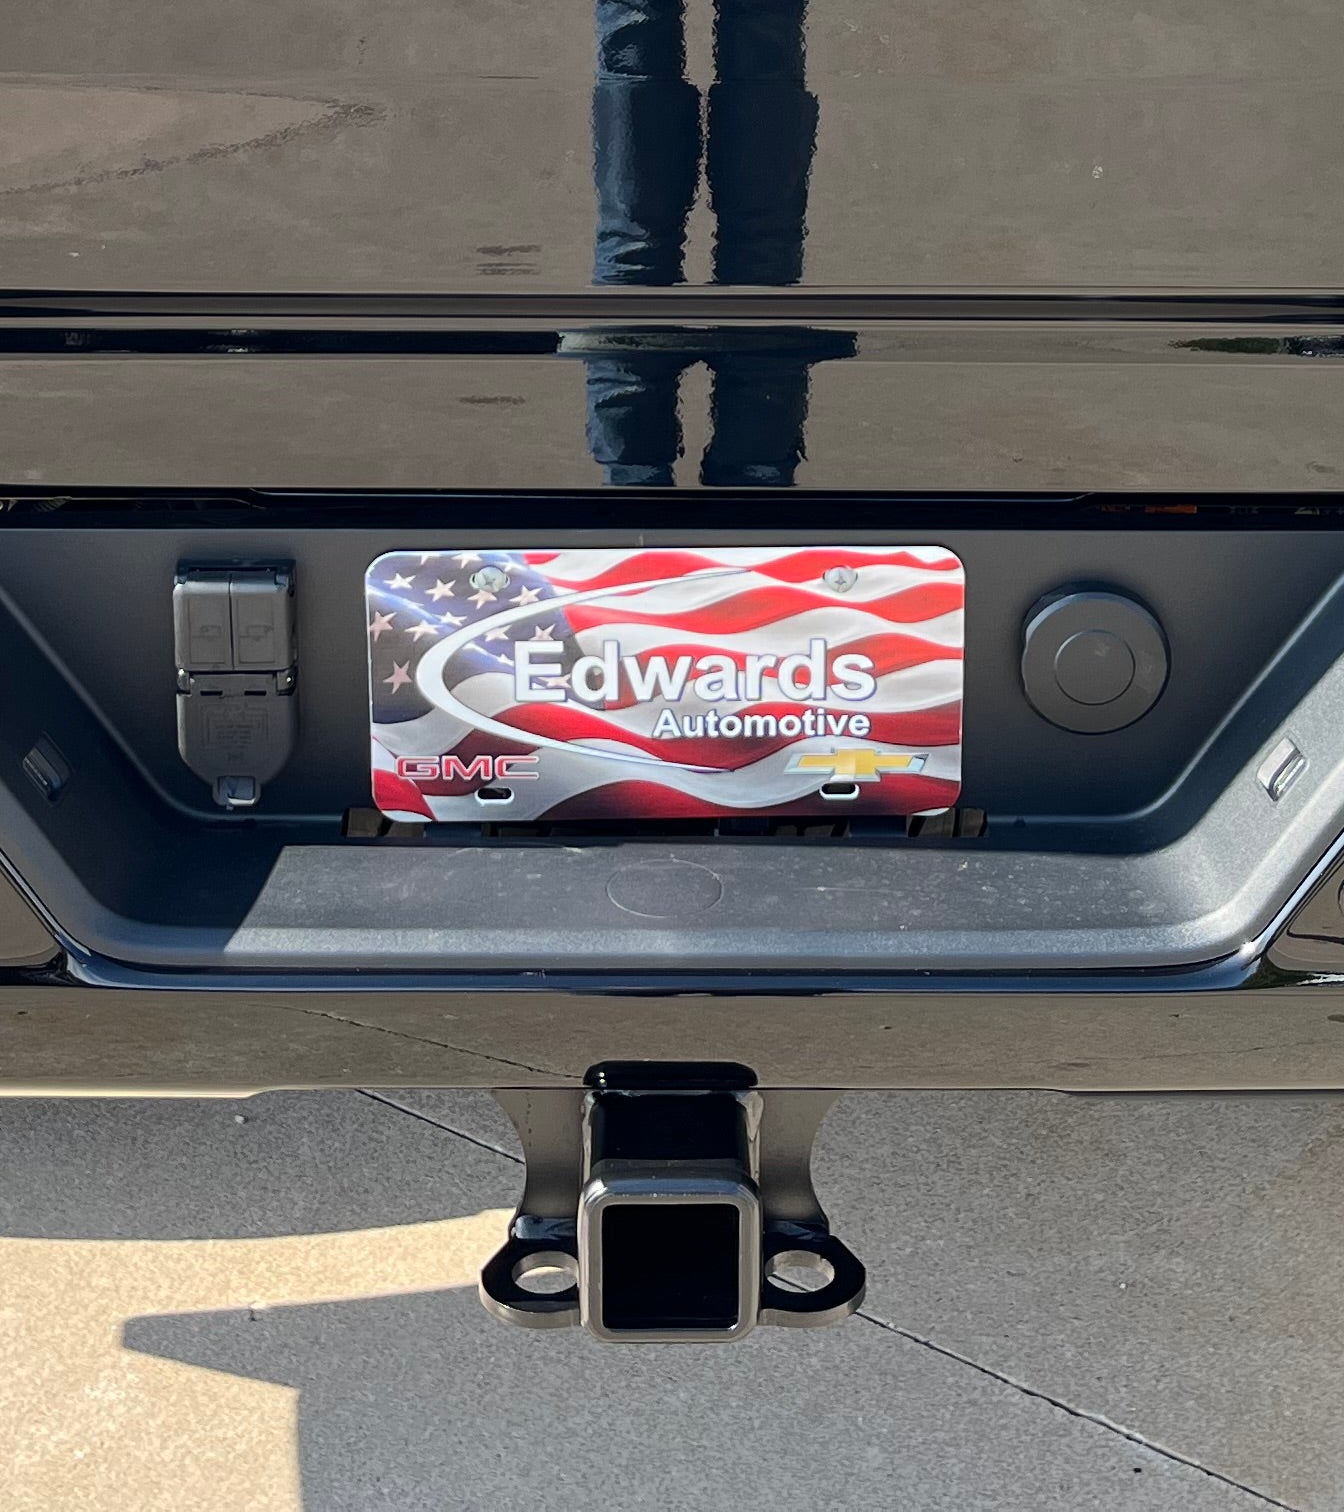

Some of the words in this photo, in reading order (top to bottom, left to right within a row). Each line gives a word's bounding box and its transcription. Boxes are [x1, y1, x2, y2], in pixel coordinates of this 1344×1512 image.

[514, 638, 877, 702] Edwards
[654, 708, 871, 738] Automotive
[396, 755, 540, 780] GMC
